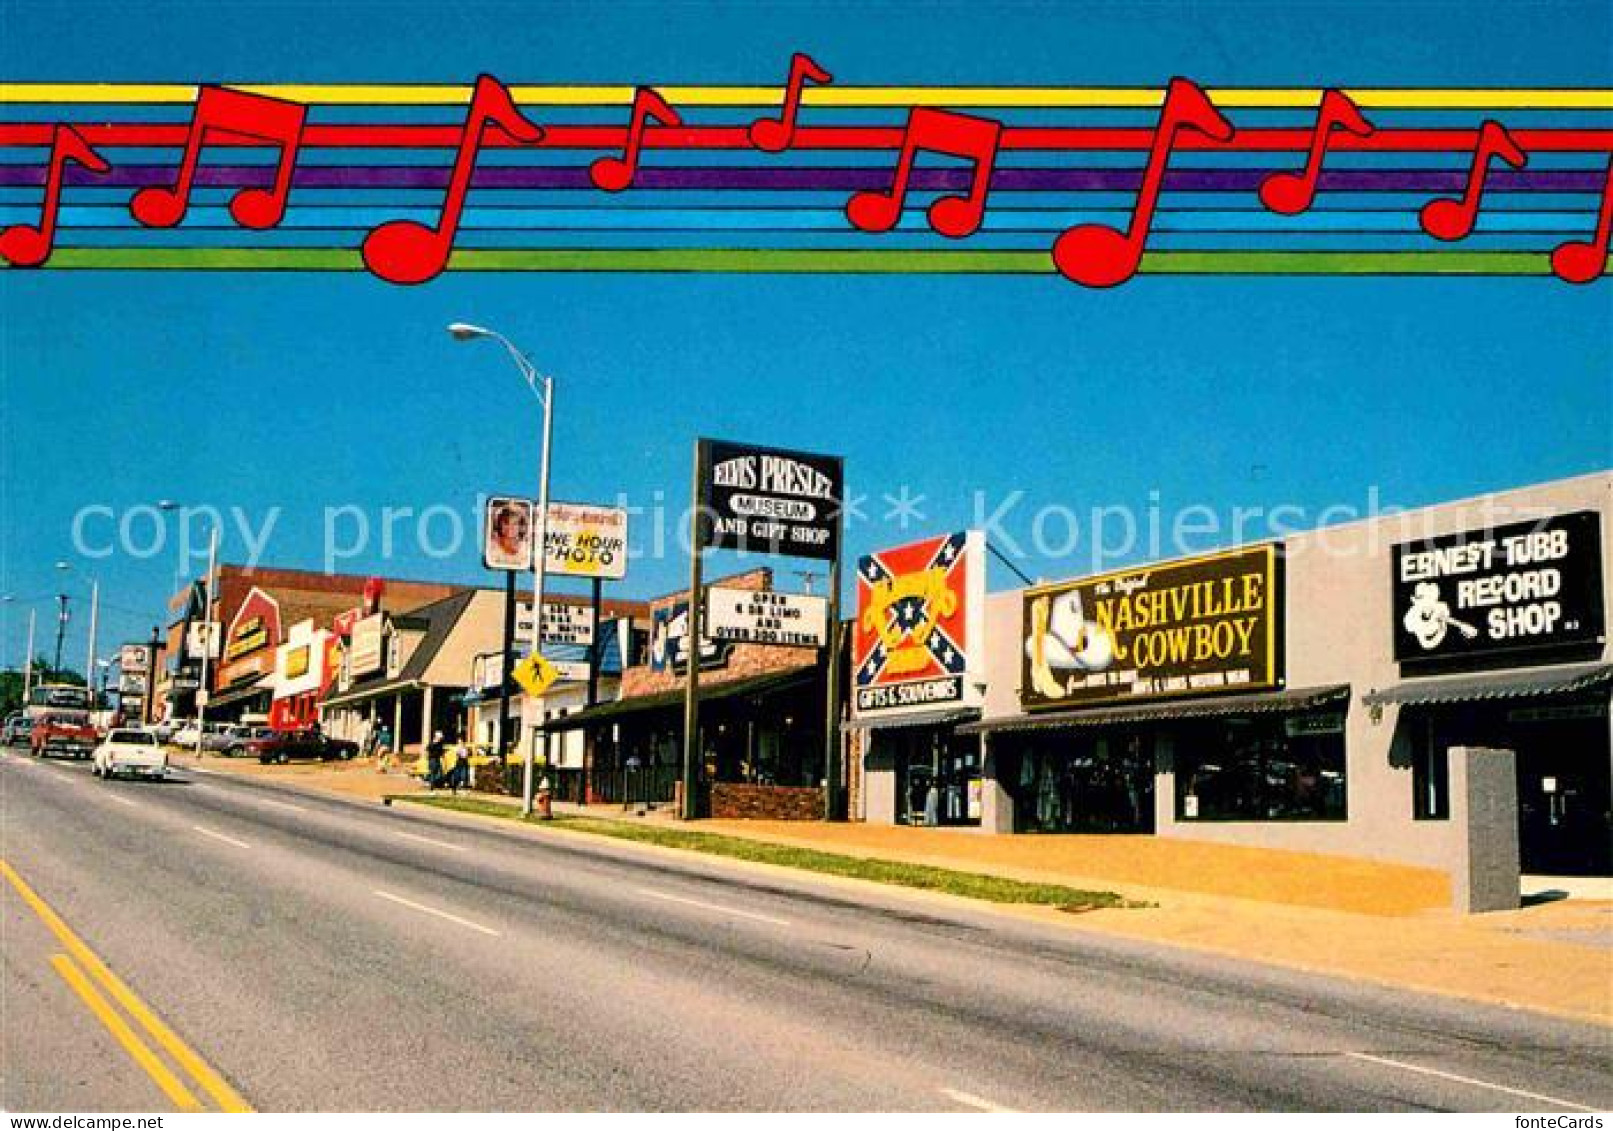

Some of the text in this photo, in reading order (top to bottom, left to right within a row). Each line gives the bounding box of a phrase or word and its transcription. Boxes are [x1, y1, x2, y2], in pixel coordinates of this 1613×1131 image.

[713, 455, 757, 489] ELVIS
[736, 498, 810, 518] MUSEUM
[577, 534, 623, 550] HOUR
[713, 518, 830, 545] AND GIFT SHOP
[1400, 529, 1569, 583] ERNEST TUBB
[1096, 572, 1264, 631] NASHVILLE
[1457, 568, 1561, 609] RECORD
[1488, 601, 1562, 639] SHOP
[1134, 617, 1258, 669] COWBOY
